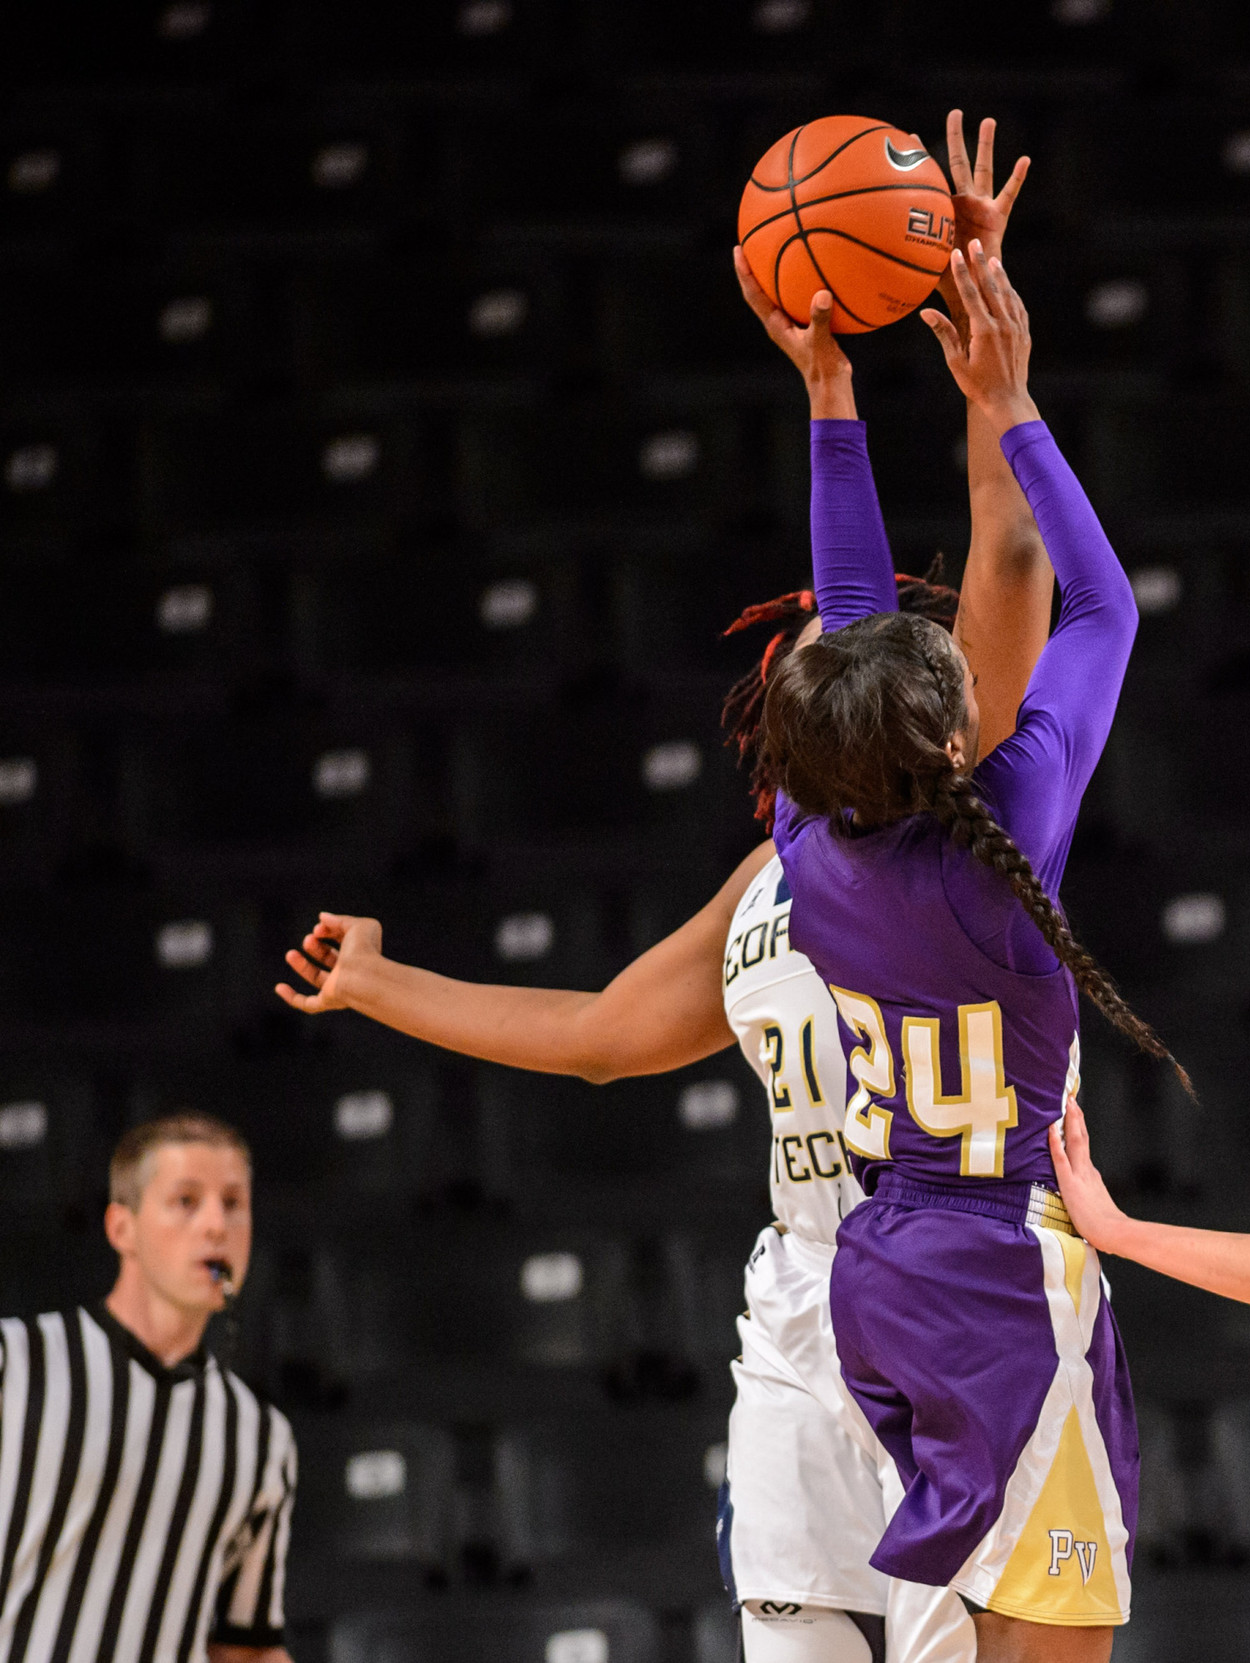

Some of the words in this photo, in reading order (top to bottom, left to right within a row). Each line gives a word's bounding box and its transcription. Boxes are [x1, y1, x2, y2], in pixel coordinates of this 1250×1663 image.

[763, 1014, 826, 1113] 21
[829, 984, 1018, 1178] 24
[1048, 1529, 1097, 1586] PV
